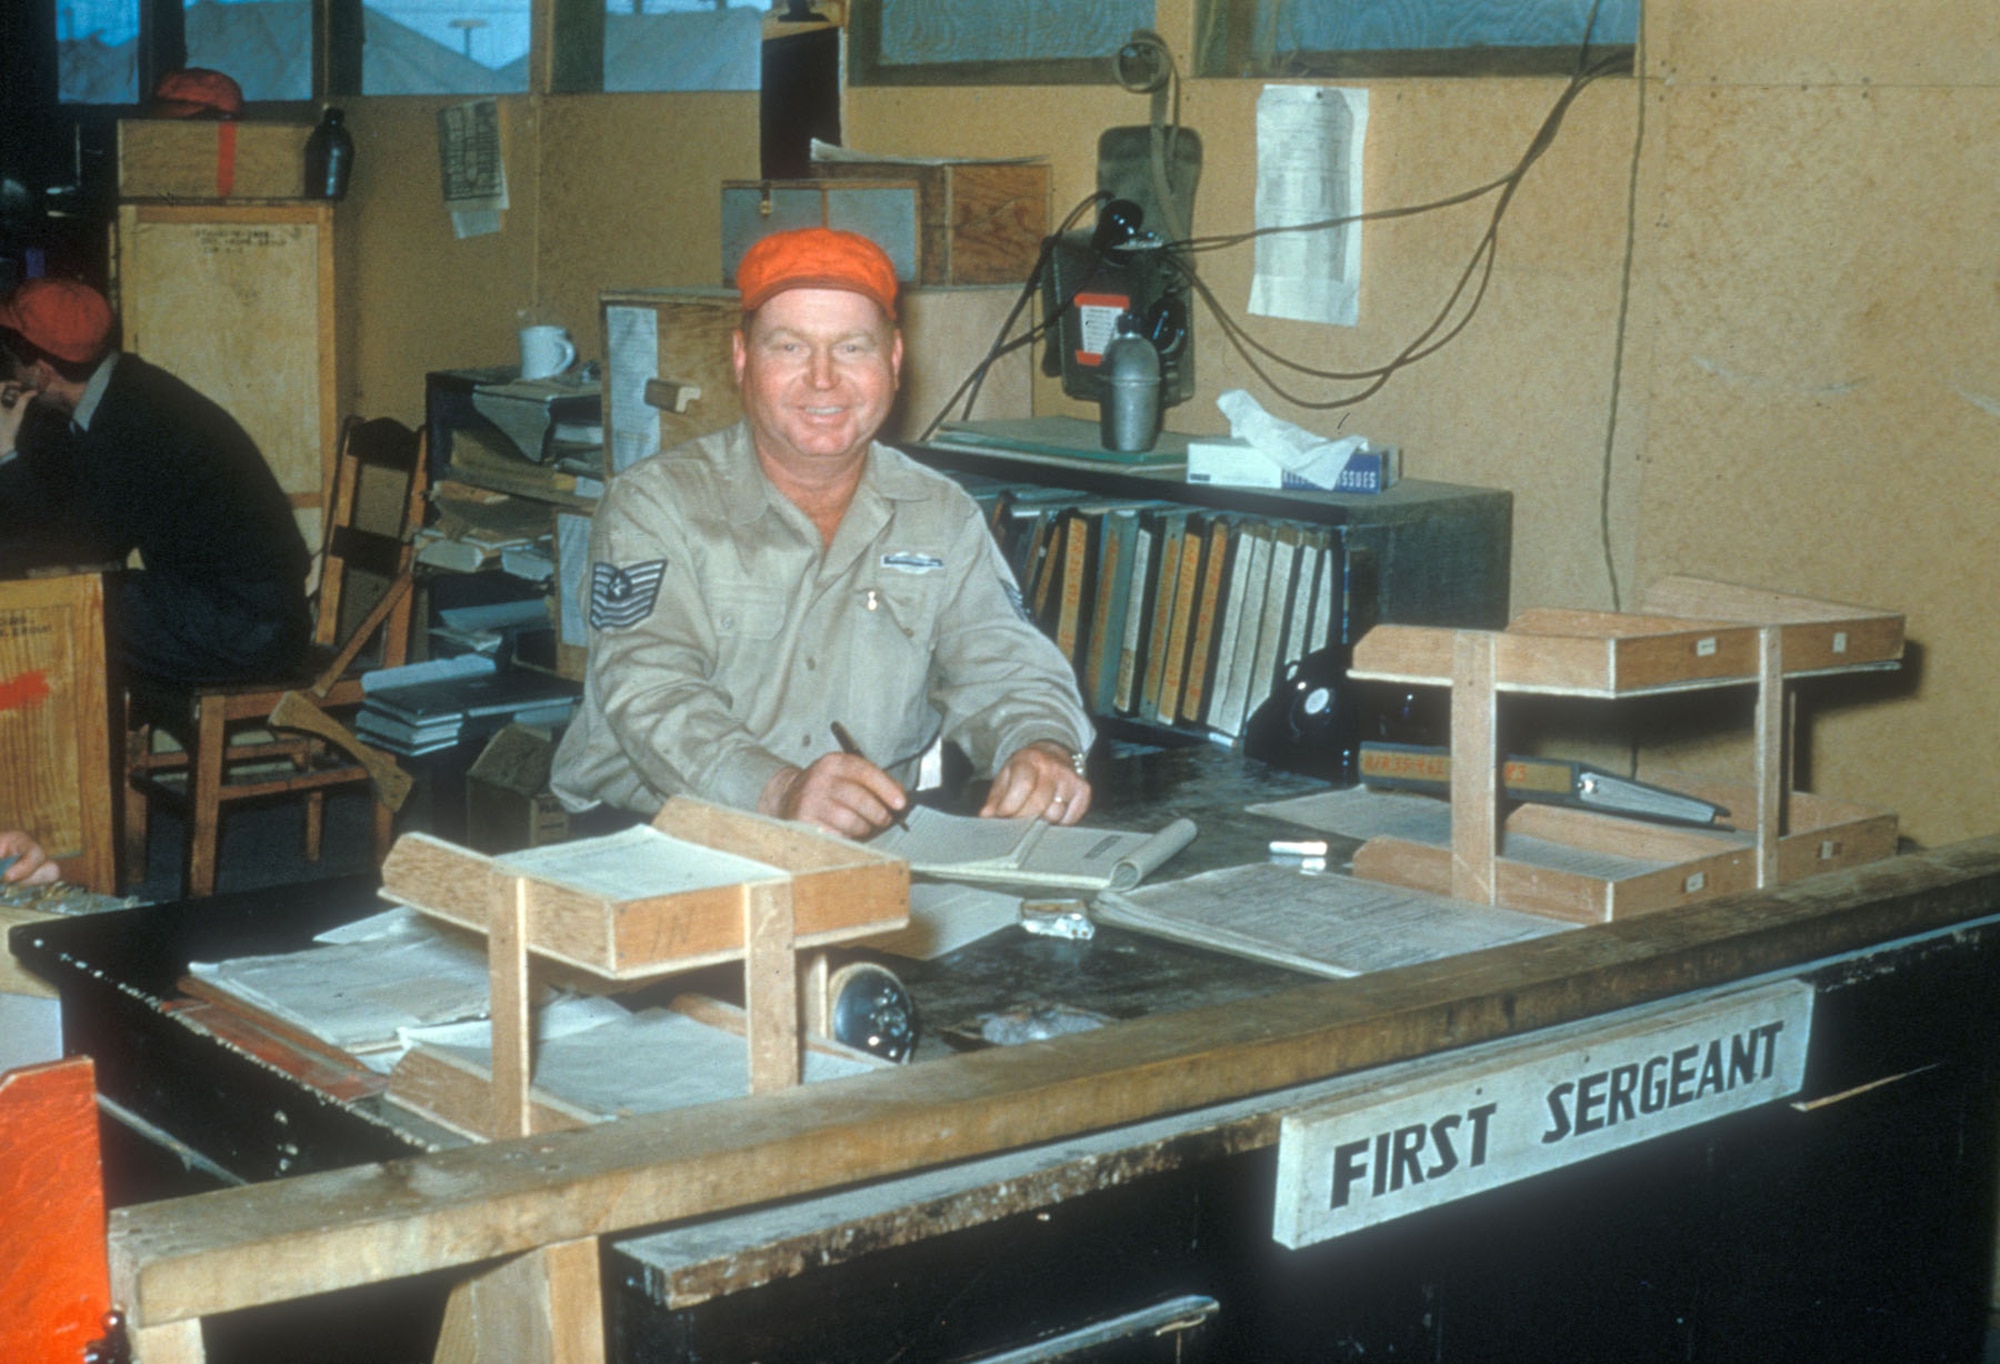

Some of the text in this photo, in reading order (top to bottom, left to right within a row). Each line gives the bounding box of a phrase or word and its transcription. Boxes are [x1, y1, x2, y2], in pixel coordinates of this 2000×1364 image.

[1336, 470, 1377, 489] SSUES
[1330, 1020, 1784, 1210] FIRST SERGEANT
